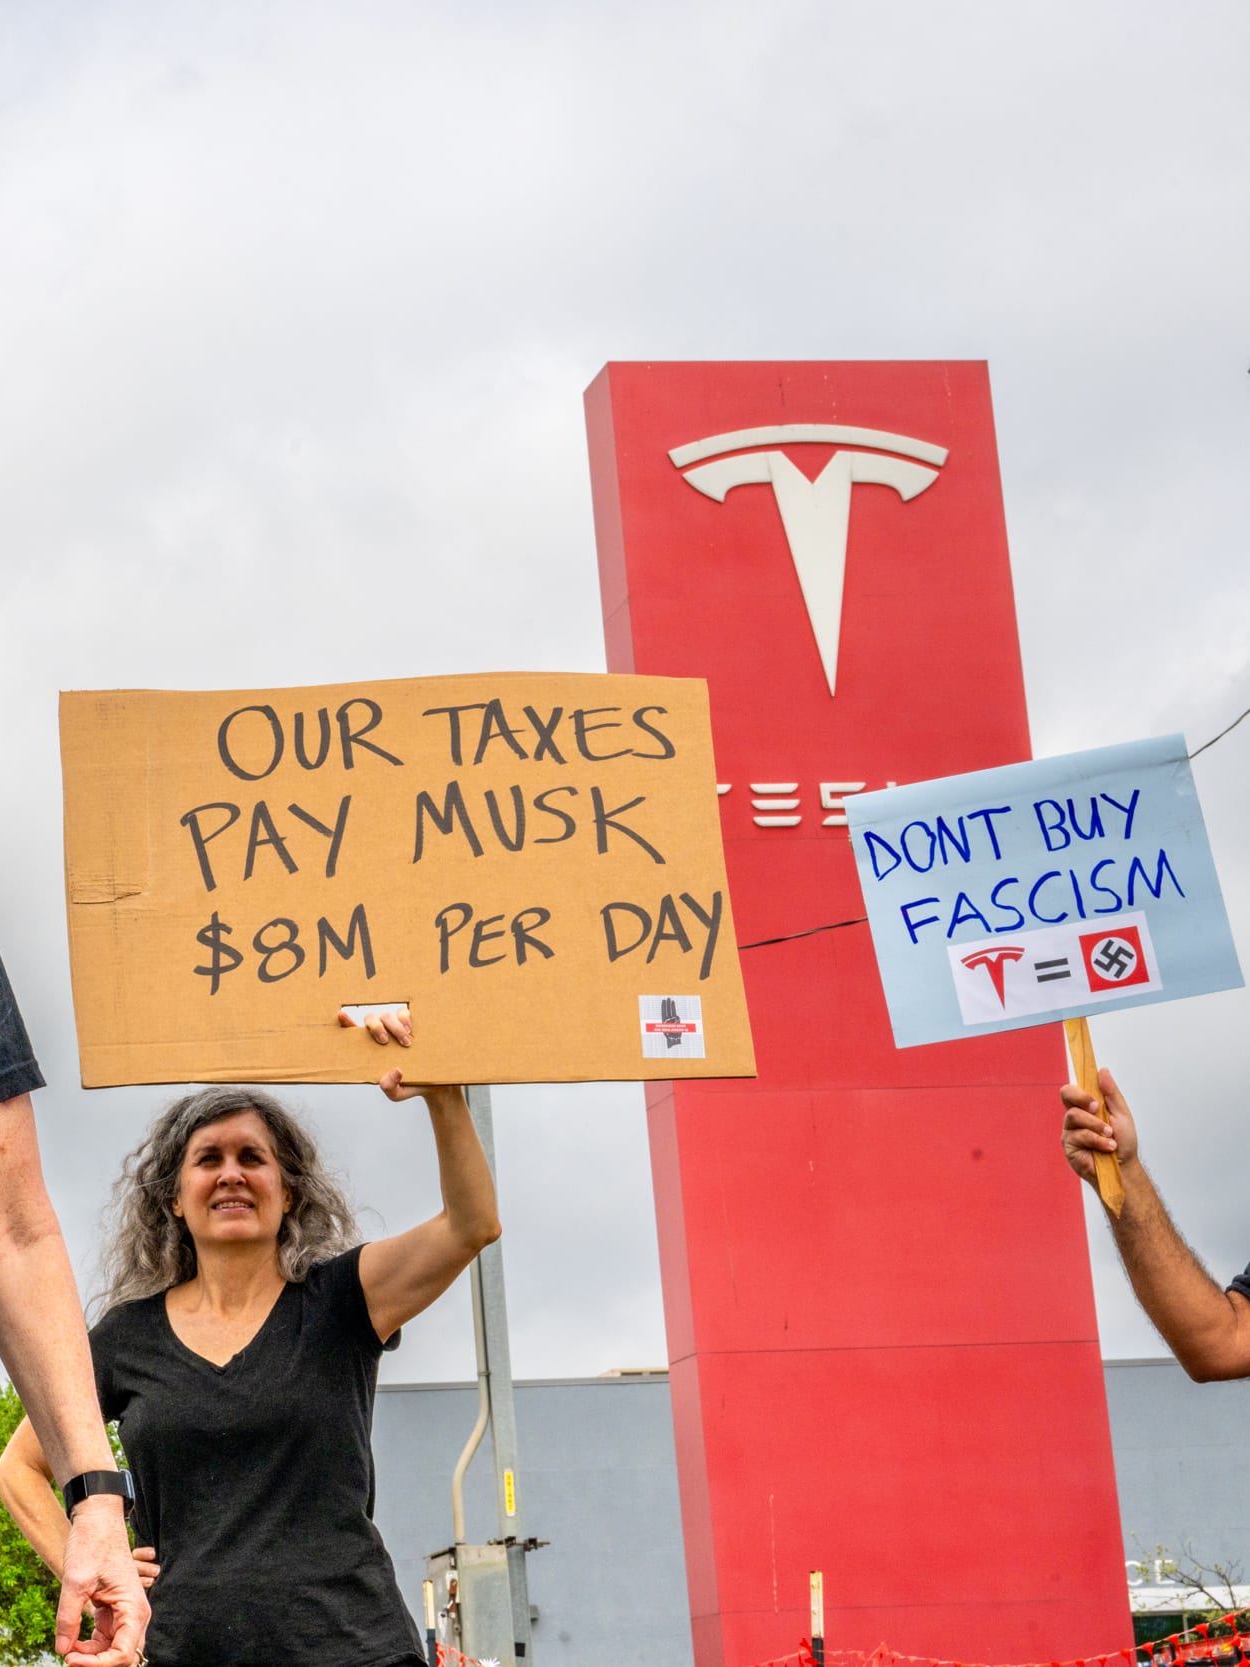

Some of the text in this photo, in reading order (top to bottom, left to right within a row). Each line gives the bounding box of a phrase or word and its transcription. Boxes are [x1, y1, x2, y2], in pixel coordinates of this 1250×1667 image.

[217, 698, 676, 781] OUR TAXES
[180, 781, 666, 892] PAY MUSK
[863, 789, 1140, 881] DONT BUY
[193, 891, 723, 995] $8M PER DAY
[901, 849, 1186, 944] FASCISM
